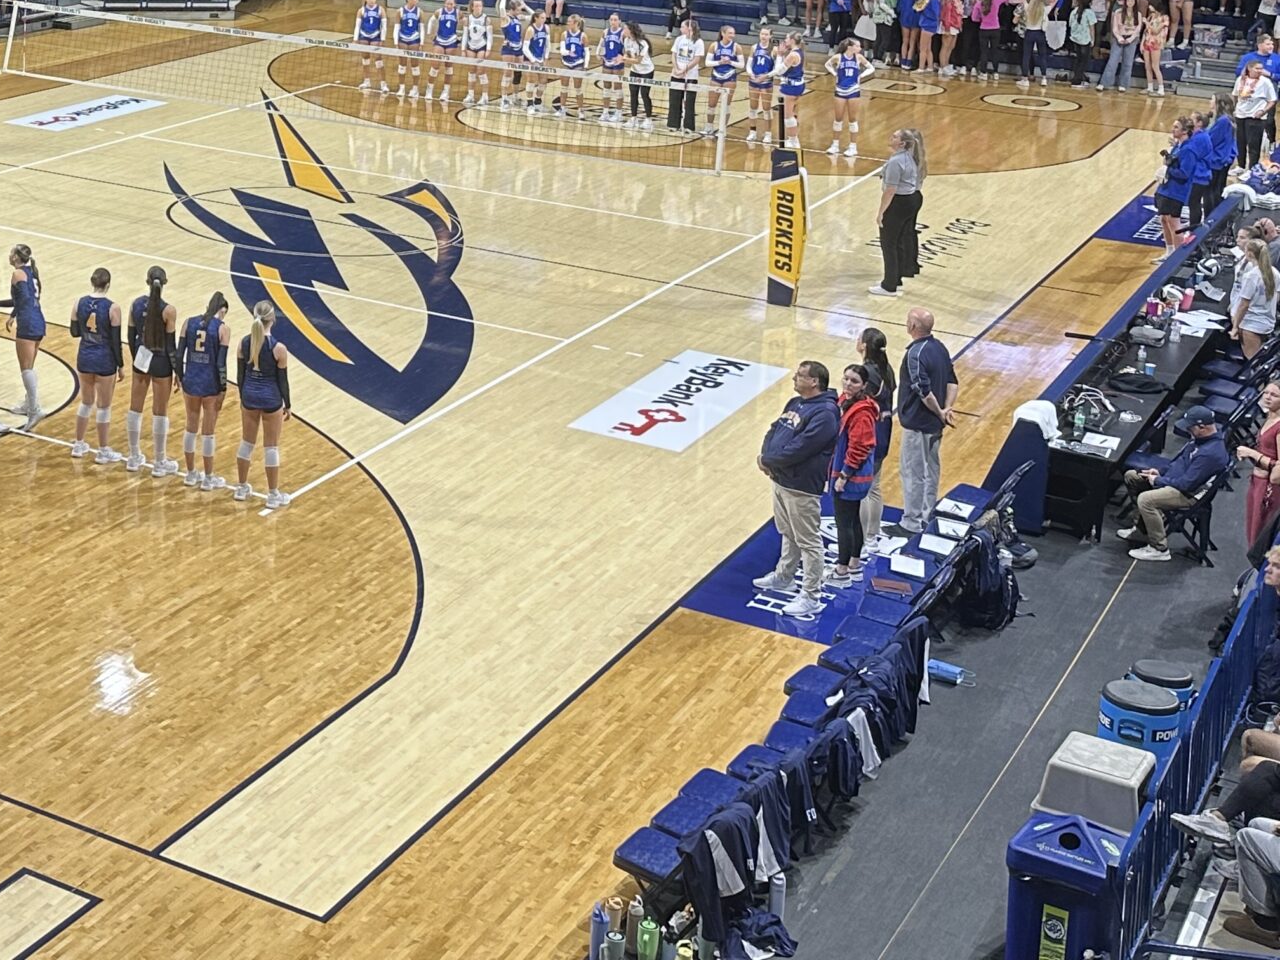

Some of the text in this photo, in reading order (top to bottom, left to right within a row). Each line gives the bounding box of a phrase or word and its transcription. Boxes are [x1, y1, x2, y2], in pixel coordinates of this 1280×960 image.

[407, 19, 413, 27] 3
[774, 189, 794, 273] ROCKETS
[86, 312, 97, 334] 4
[195, 329, 207, 352] 2
[651, 358, 750, 407] KeyBank
